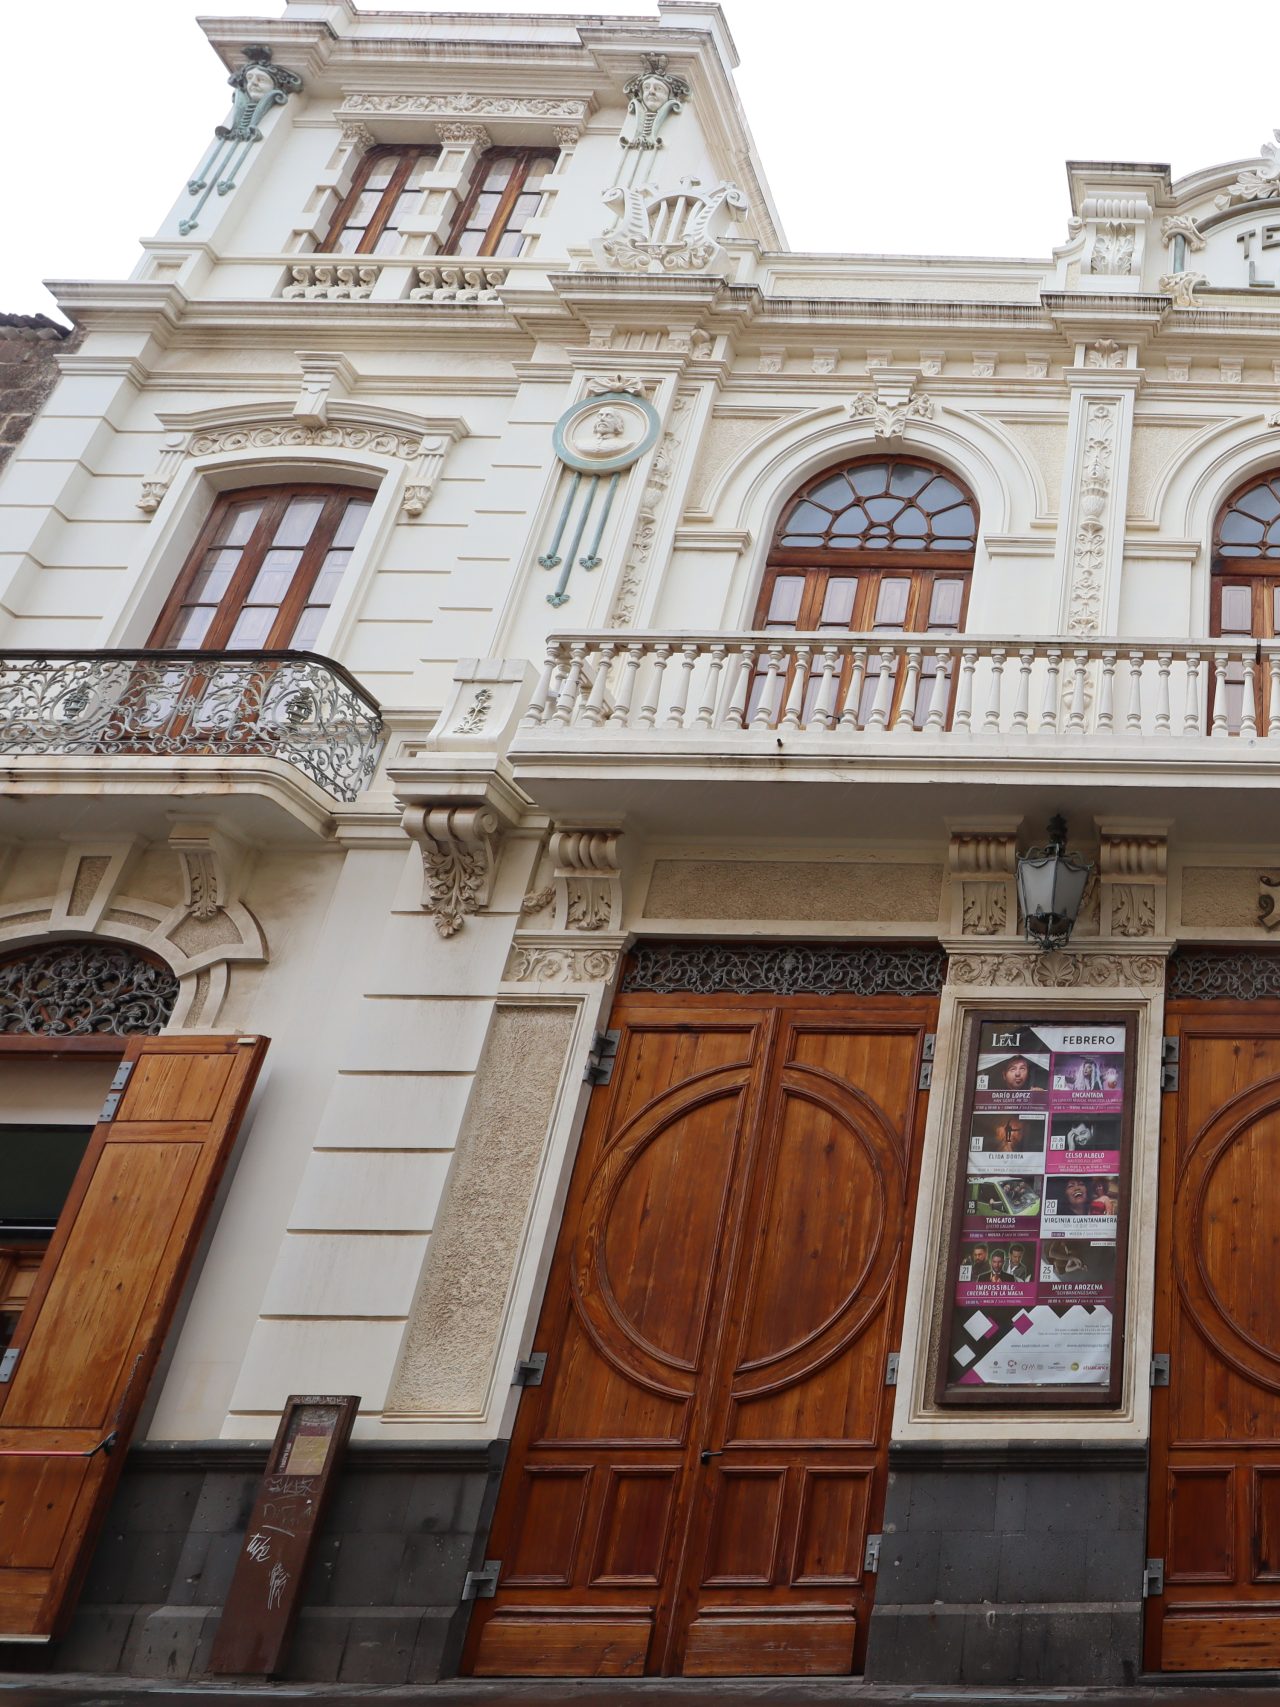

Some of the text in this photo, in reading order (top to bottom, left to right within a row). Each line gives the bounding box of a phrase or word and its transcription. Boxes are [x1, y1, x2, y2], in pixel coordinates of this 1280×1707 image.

[1062, 1035, 1115, 1045] FEBRERO
[991, 1091, 1031, 1099] DARÍO LÓPEZ
[961, 1266, 969, 1274] 21
[1042, 1266, 1052, 1274] 25
